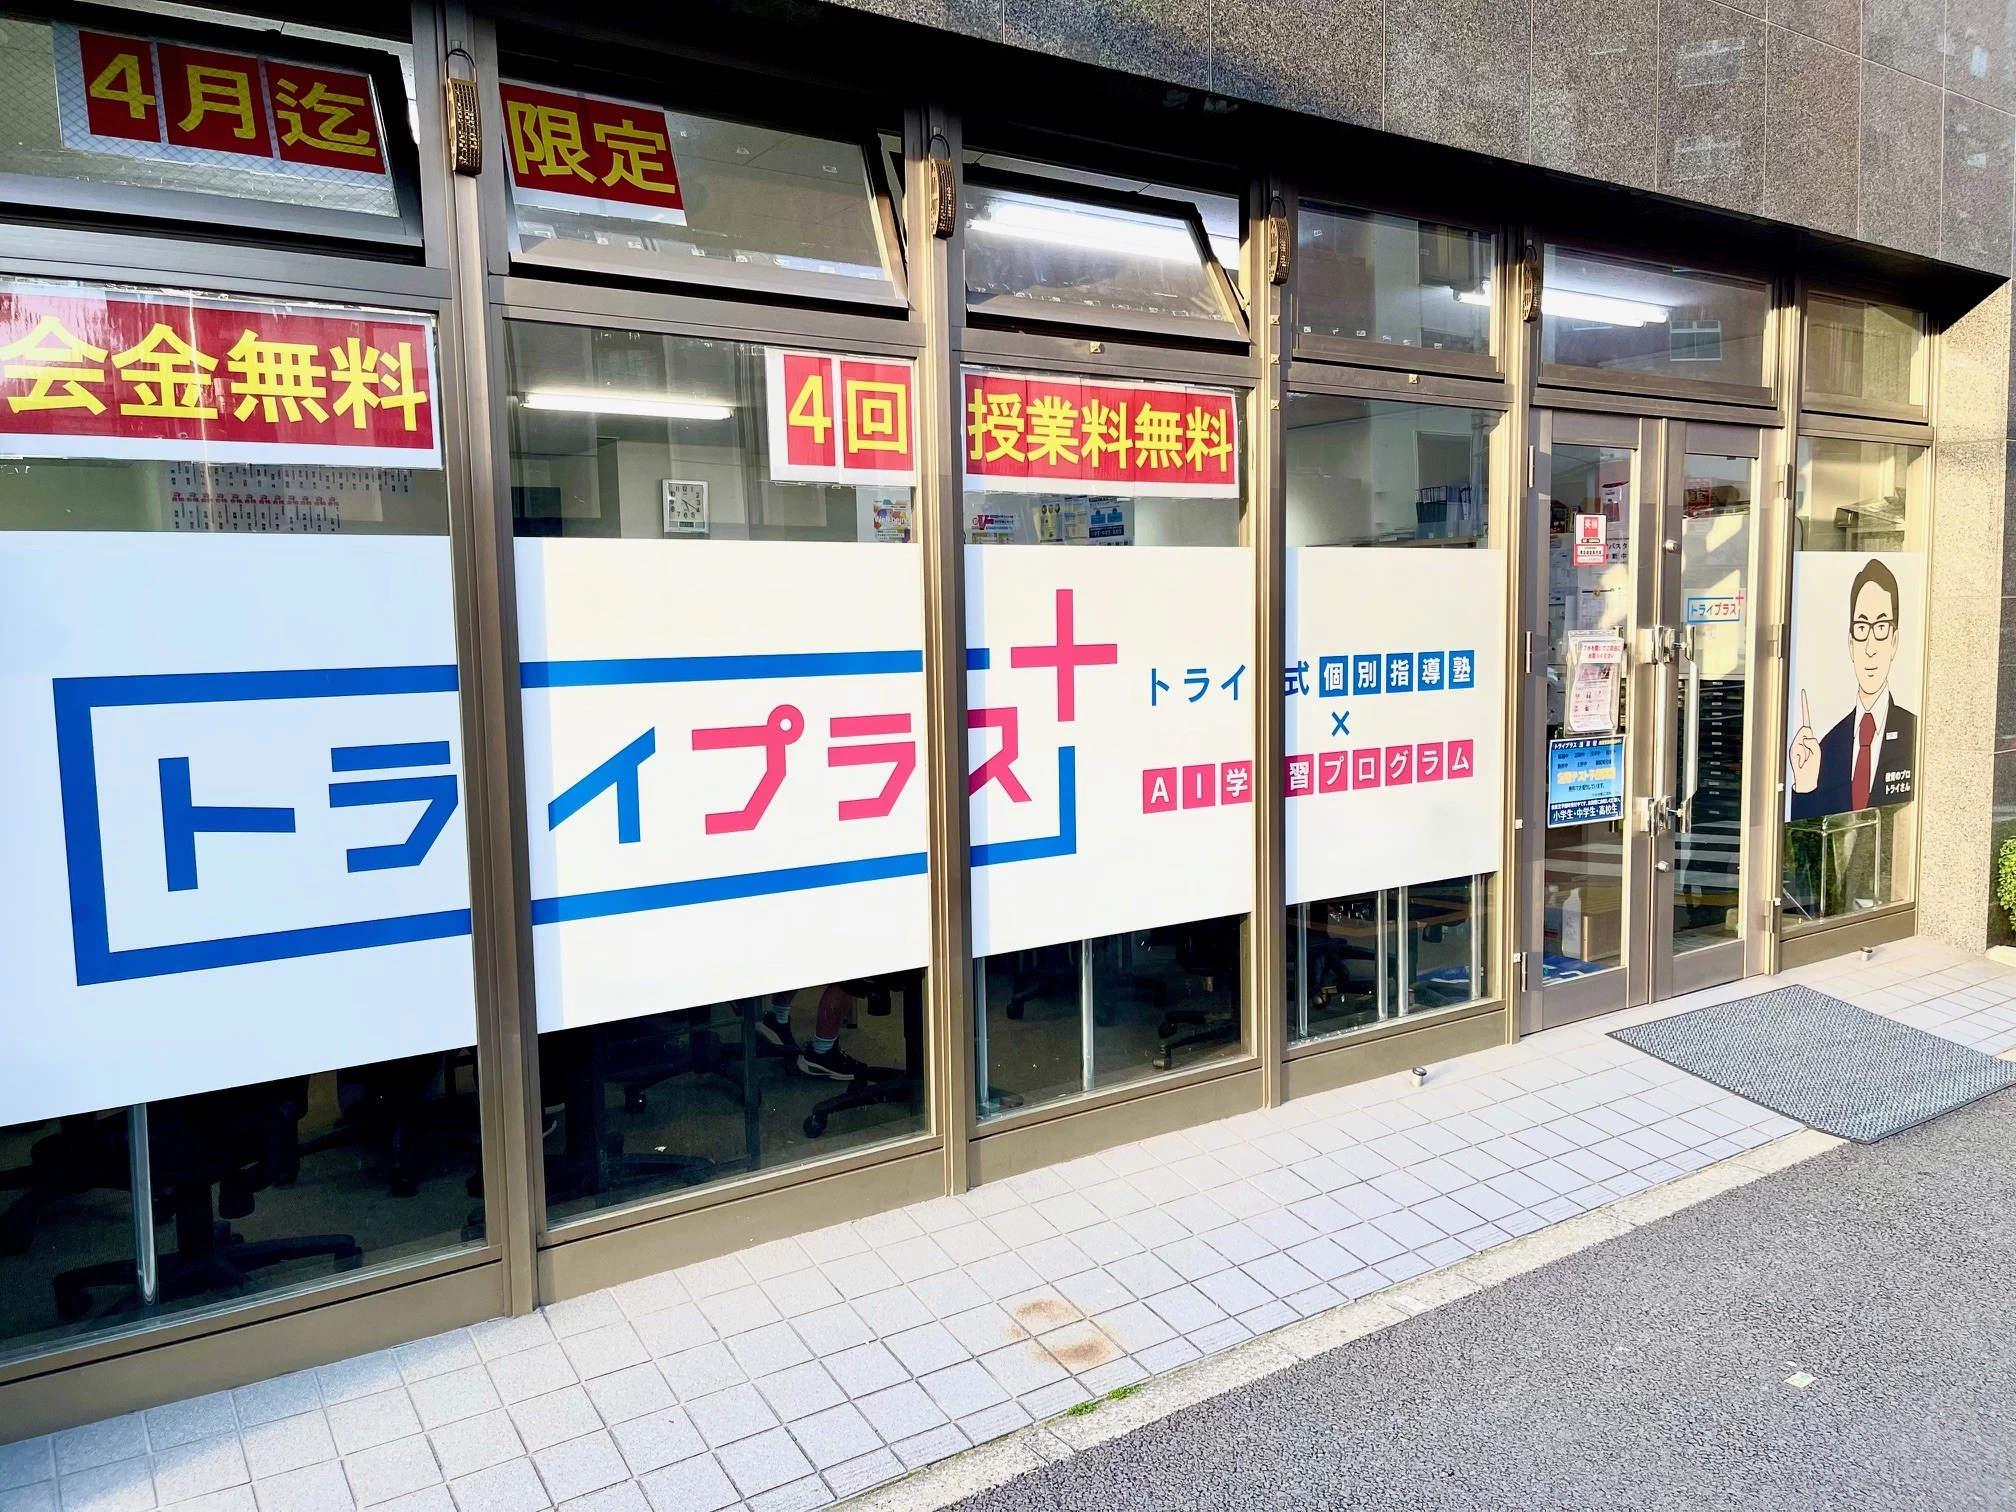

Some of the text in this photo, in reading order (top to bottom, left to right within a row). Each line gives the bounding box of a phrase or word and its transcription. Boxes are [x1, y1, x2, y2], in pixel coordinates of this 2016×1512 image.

[89, 53, 675, 195] 4月迄 限定
[0, 315, 428, 433] 会金無料
[788, 374, 1234, 474] 4回 授業料無料
[1691, 602, 1737, 616] トライプラス
[1885, 782, 1911, 795] トライさん
